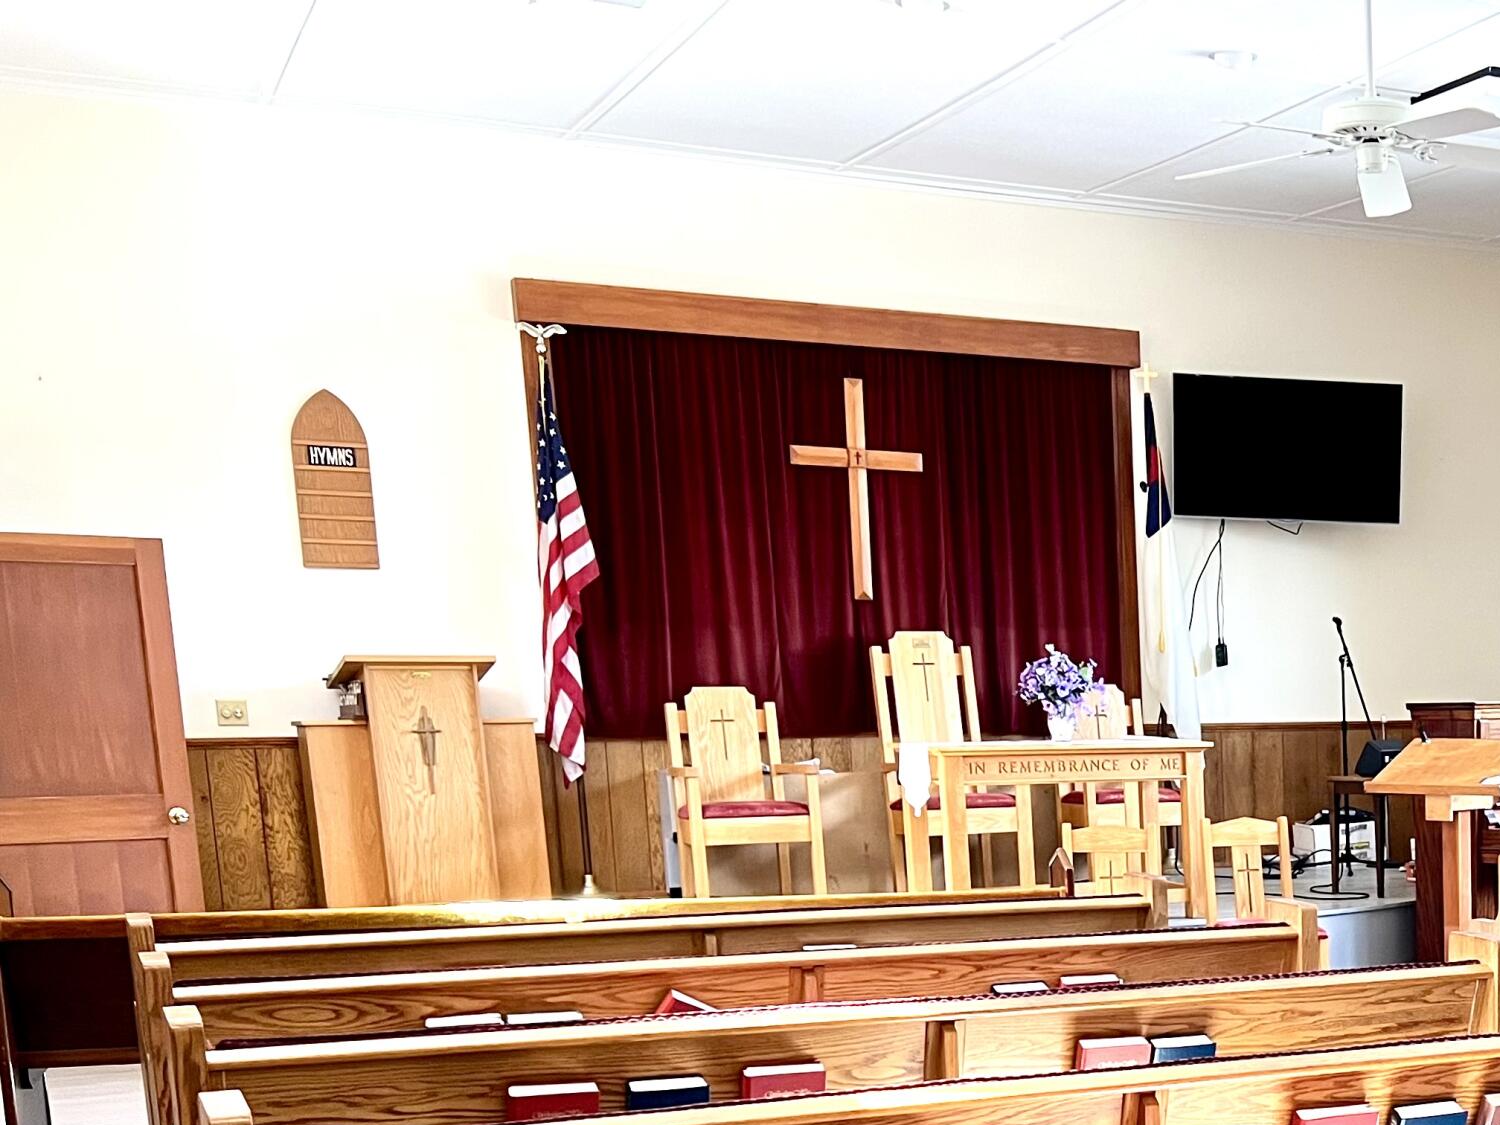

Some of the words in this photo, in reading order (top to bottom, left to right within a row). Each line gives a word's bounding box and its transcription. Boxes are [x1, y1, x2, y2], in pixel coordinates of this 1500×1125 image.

[309, 446, 354, 466] HYMNS
[969, 762, 985, 774] IN
[998, 759, 1120, 774] REMEMBRANCE
[1130, 758, 1149, 770] OF
[1160, 758, 1180, 770] ME
